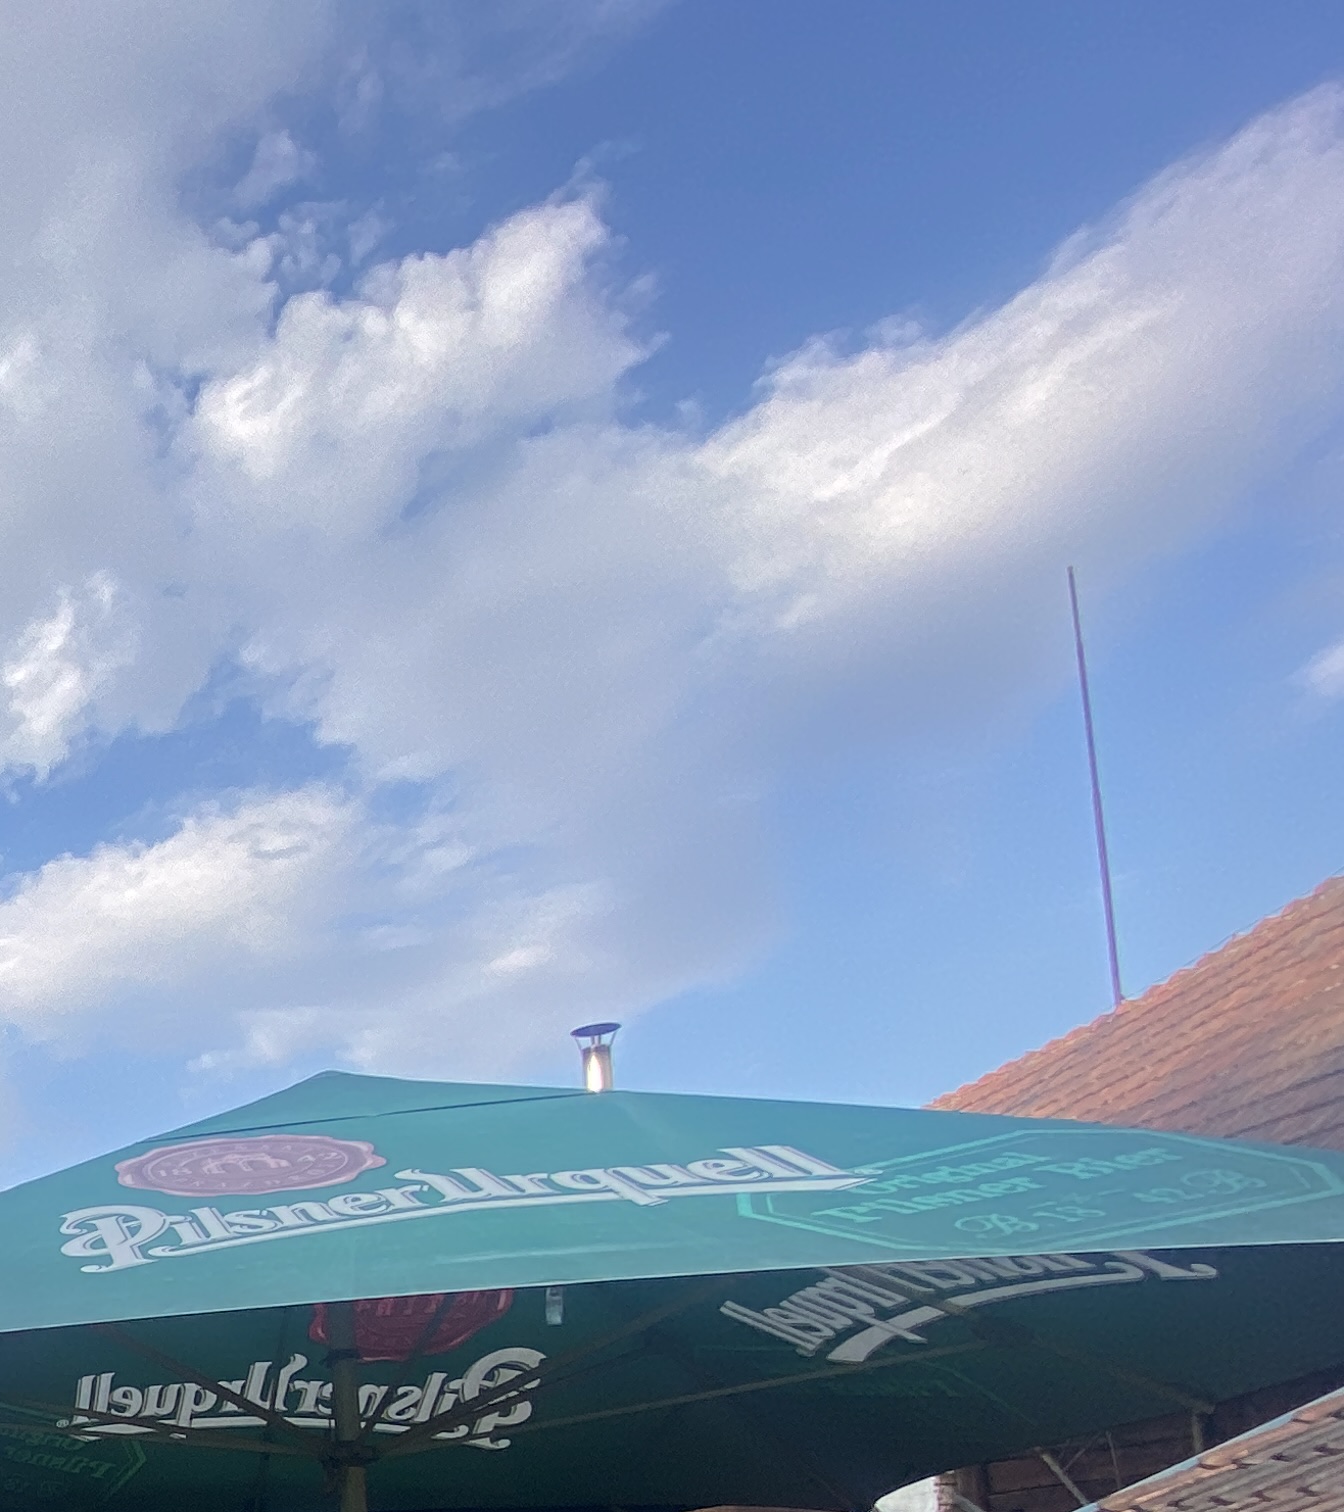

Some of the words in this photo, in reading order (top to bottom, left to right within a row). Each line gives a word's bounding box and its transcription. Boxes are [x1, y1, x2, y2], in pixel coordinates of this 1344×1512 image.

[59, 1182, 430, 1273] Pilsner
[394, 1144, 853, 1207] Urquell
[811, 1176, 1047, 1223] Pilsner
[1033, 1147, 1184, 1180] Bier
